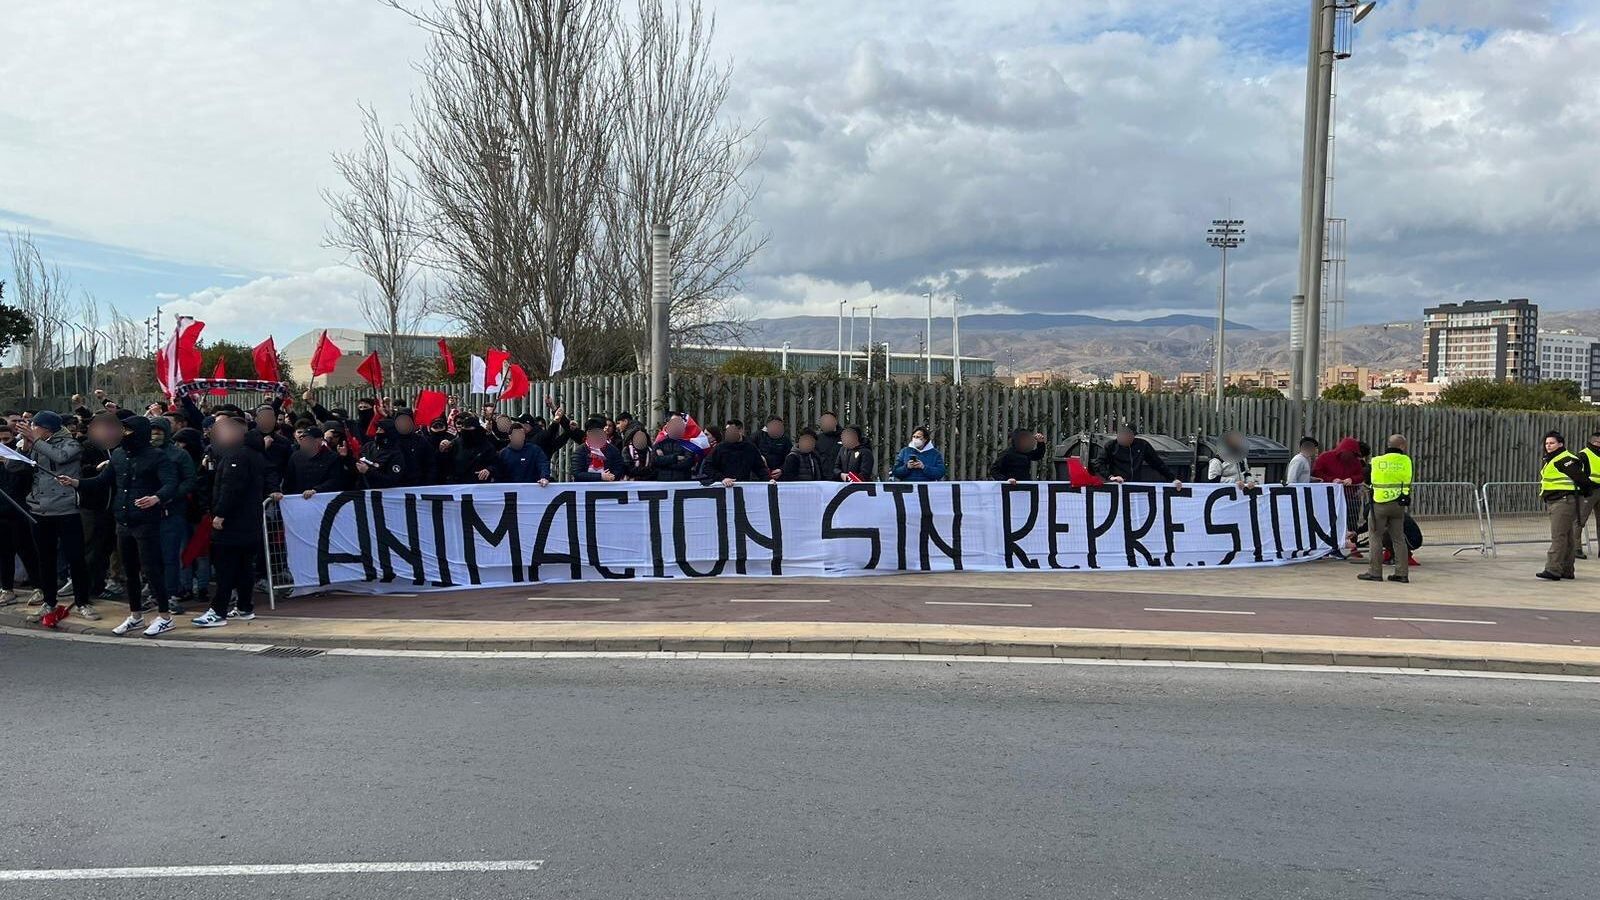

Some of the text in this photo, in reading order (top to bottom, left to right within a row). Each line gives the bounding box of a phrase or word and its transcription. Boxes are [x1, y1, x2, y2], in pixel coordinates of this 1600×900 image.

[318, 483, 1338, 587] ANIMACION SIN REPRESION
